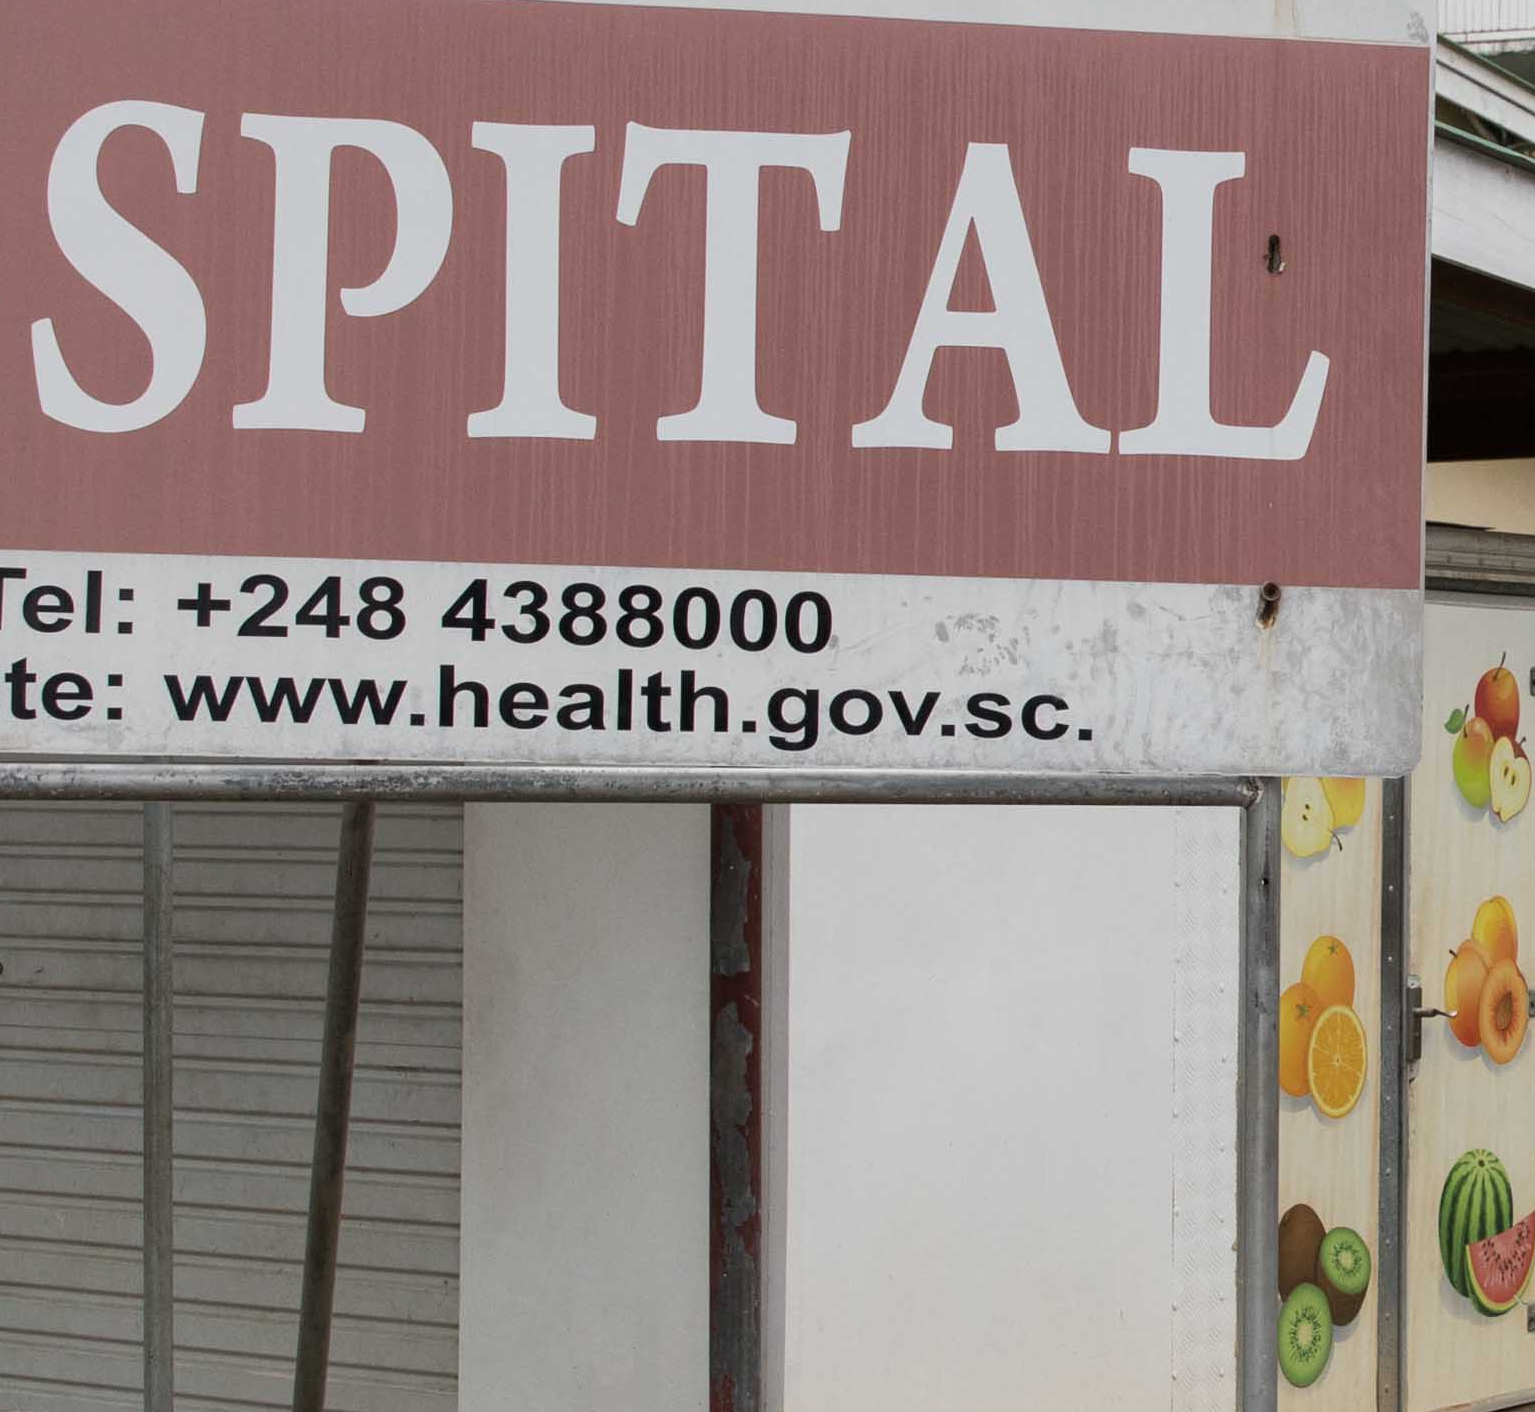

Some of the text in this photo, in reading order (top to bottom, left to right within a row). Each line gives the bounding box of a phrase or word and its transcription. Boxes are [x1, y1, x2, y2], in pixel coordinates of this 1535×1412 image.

[177, 574, 406, 640] +248
[441, 578, 832, 654] 4388000
[163, 664, 1093, 752] www.health.gov.sc.
